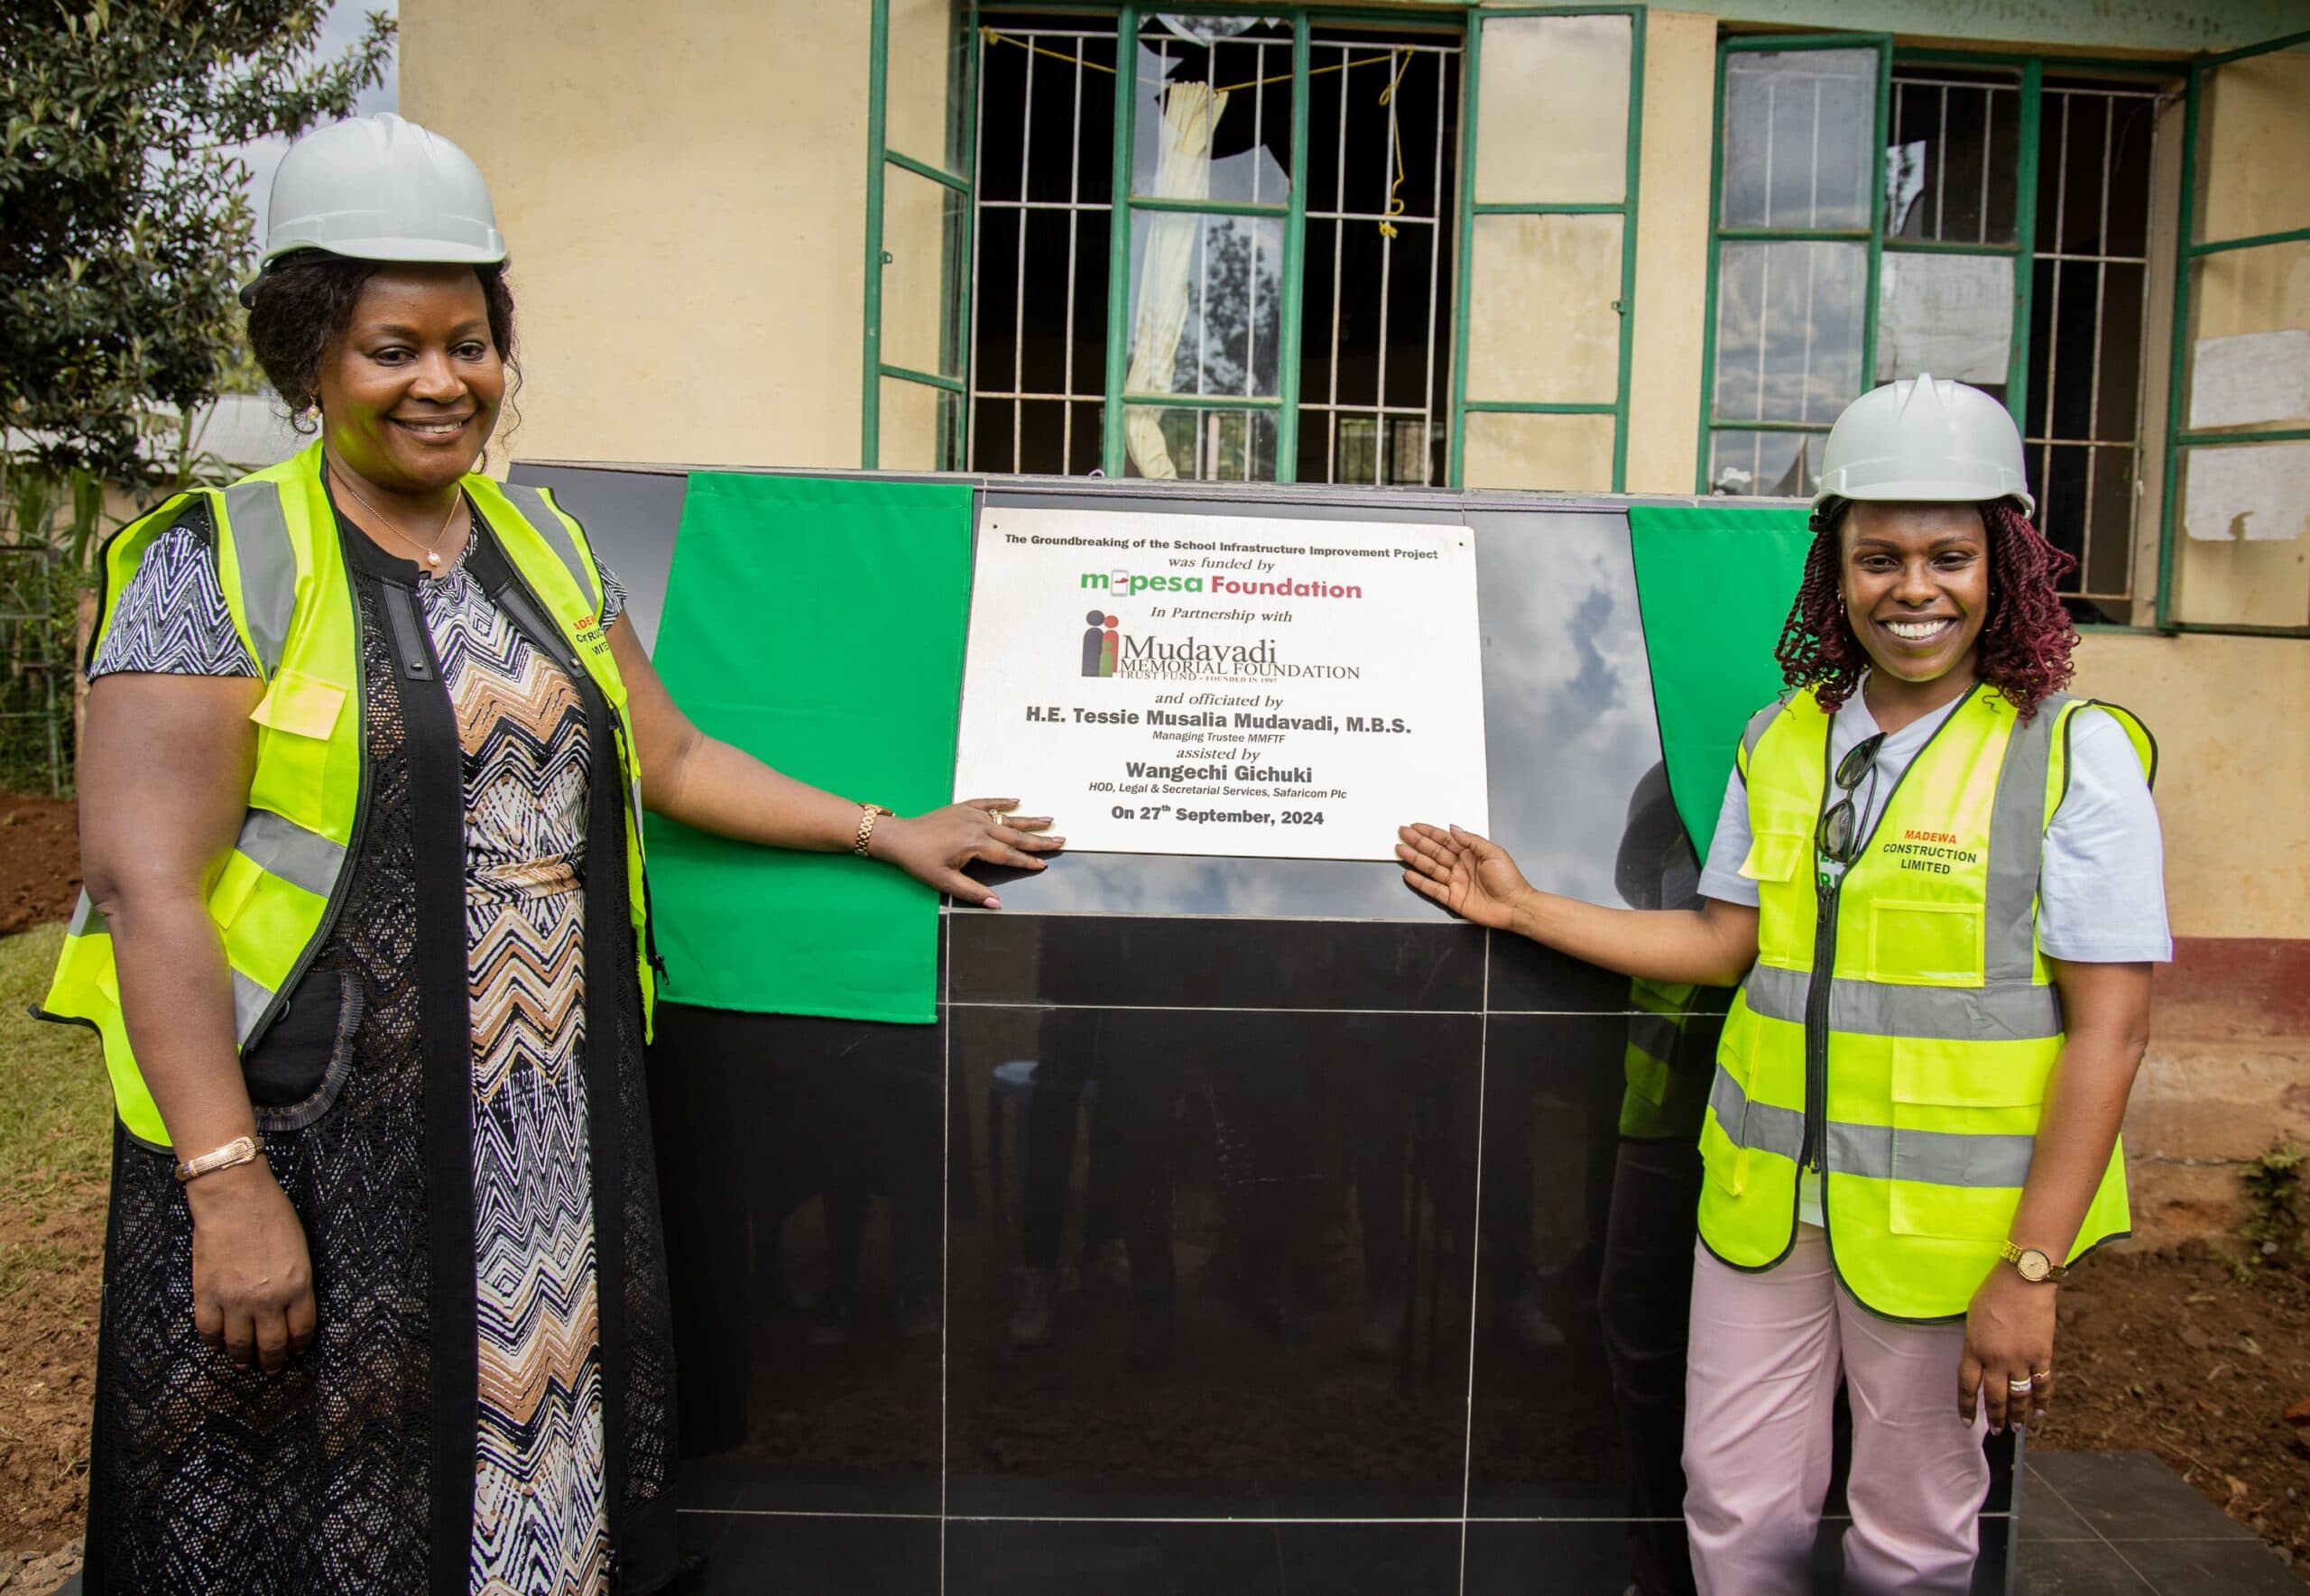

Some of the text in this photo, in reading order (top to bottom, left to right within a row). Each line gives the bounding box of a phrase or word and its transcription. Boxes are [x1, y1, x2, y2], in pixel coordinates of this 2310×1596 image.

[1004, 533, 1438, 561] The Groundbreaking of the School Infrastructure Improvement Project
[1169, 556, 1276, 574] was funded by
[1211, 575, 1363, 599] Foundation
[1150, 606, 1293, 624] In Partnership with
[1123, 634, 1277, 664] Mudavadi
[1119, 670, 1159, 679] TRUST
[1163, 671, 1197, 681] FUND
[1120, 659, 1361, 679] MEMORIAL FOUNDATION
[1154, 692, 1284, 711] and officiated by
[1025, 706, 1412, 735] H.E. Tessie Musalia Mudavadi, M.B.S.
[1152, 730, 1287, 744] Managing Trustee MMFTF
[1176, 747, 1261, 764] assisted by
[1125, 761, 1313, 784] Wangechi Gichuki
[1088, 781, 1348, 799] HOD, Legal & Secretarial Services, Safaricom Plc
[1111, 804, 1325, 827] On 27th September, 2024
[1905, 830, 1956, 844] MADEWA
[1883, 844, 1977, 863] CONSTRUCTION
[1900, 859, 1951, 875] LIMITED
